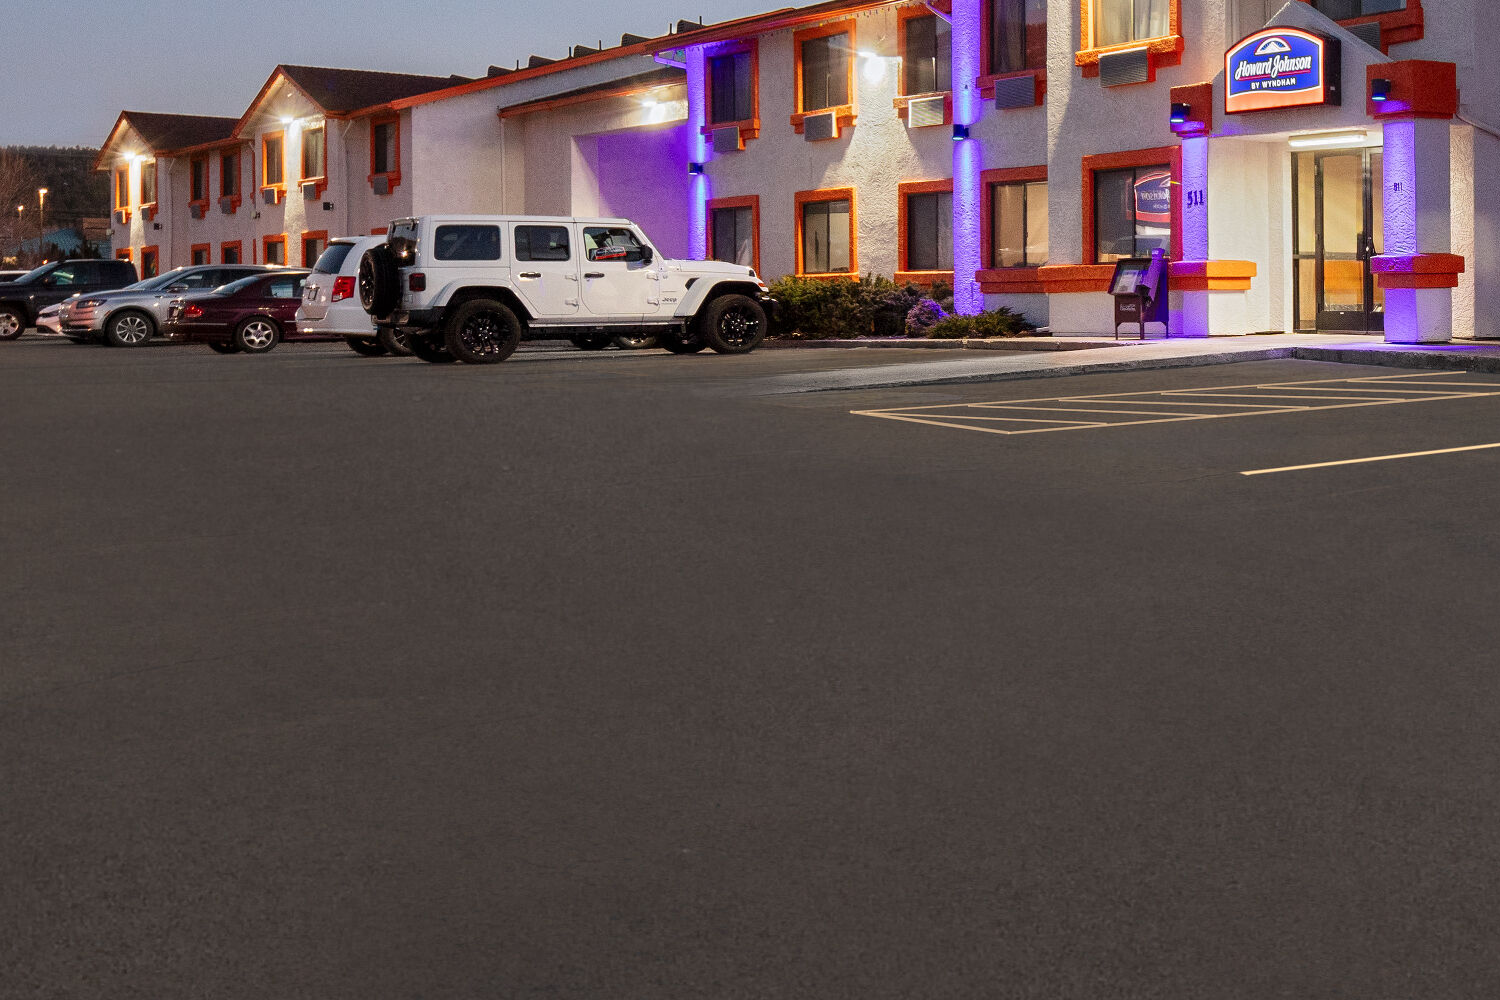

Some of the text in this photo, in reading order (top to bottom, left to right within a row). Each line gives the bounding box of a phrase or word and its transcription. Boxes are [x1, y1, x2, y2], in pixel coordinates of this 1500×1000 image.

[1234, 54, 1312, 81] Howard Johnson
[1251, 77, 1296, 90] BY WYNDHAM
[1187, 189, 1204, 206] 511
